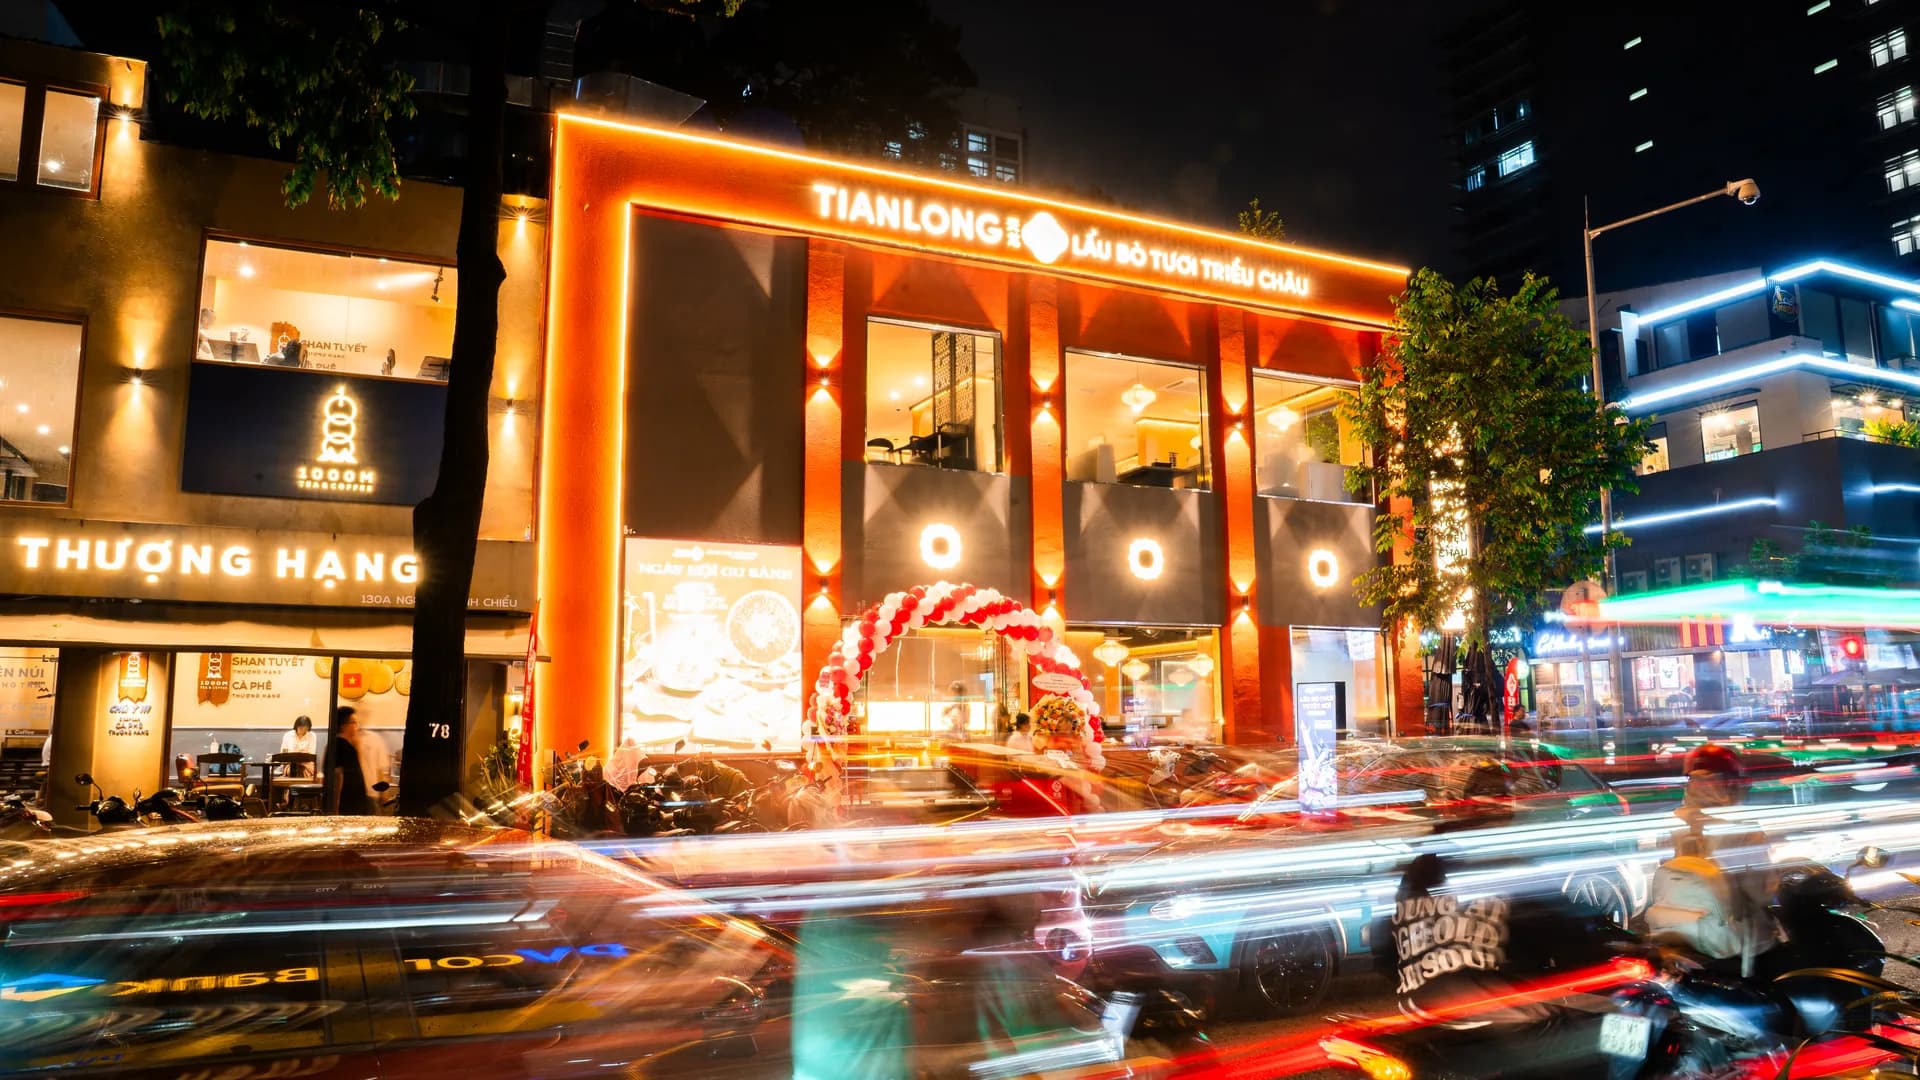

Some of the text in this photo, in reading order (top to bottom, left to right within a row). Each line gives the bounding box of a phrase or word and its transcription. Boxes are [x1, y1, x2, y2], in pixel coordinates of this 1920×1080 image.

[813, 184, 1003, 244] TIANLONG
[1116, 241, 1147, 267] BÒ
[1258, 270, 1309, 296] CHÂU
[297, 467, 375, 483] 1000M
[17, 537, 419, 588] THƯỢNG HẠNG
[361, 594, 392, 604] 130A
[232, 657, 265, 666] SHAN
[232, 679, 272, 691] CÀ PHÊ
[428, 722, 451, 739] 78
[1392, 895, 1457, 925] OUNG
